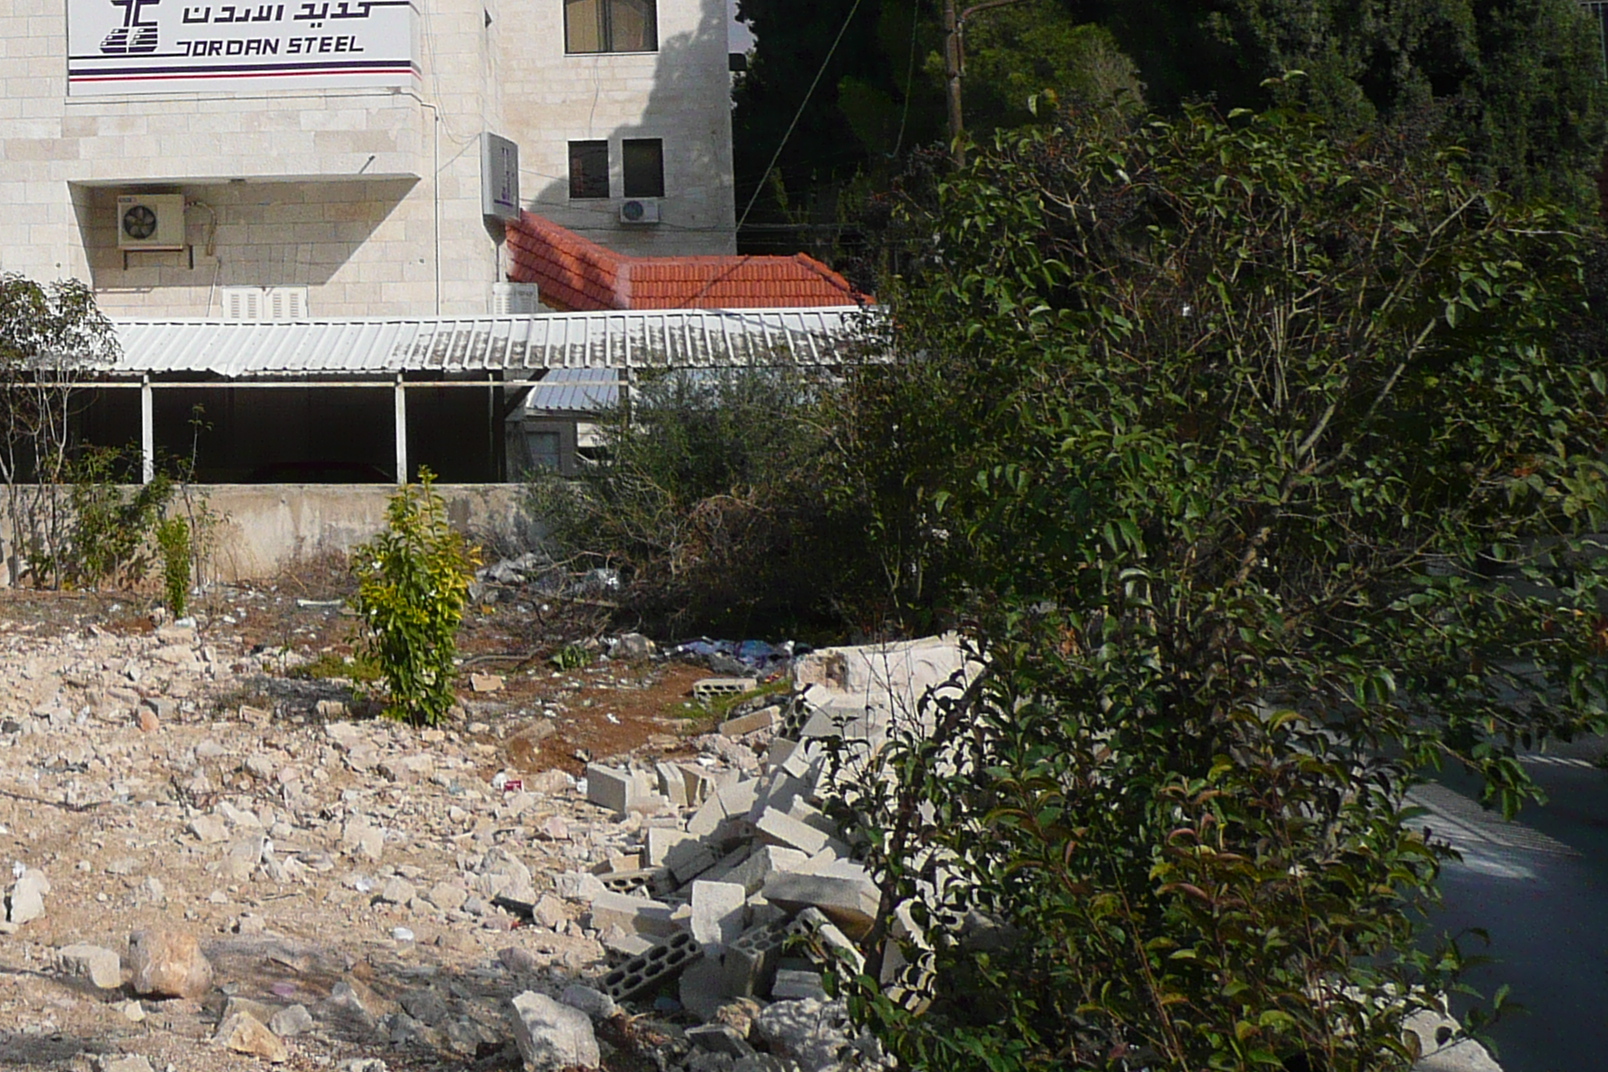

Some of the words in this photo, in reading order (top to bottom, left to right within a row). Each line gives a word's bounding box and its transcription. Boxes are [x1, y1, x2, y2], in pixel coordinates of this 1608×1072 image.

[294, 1, 376, 28] حديد
[176, 38, 280, 57] JORDAN
[286, 35, 365, 54] STEEL
